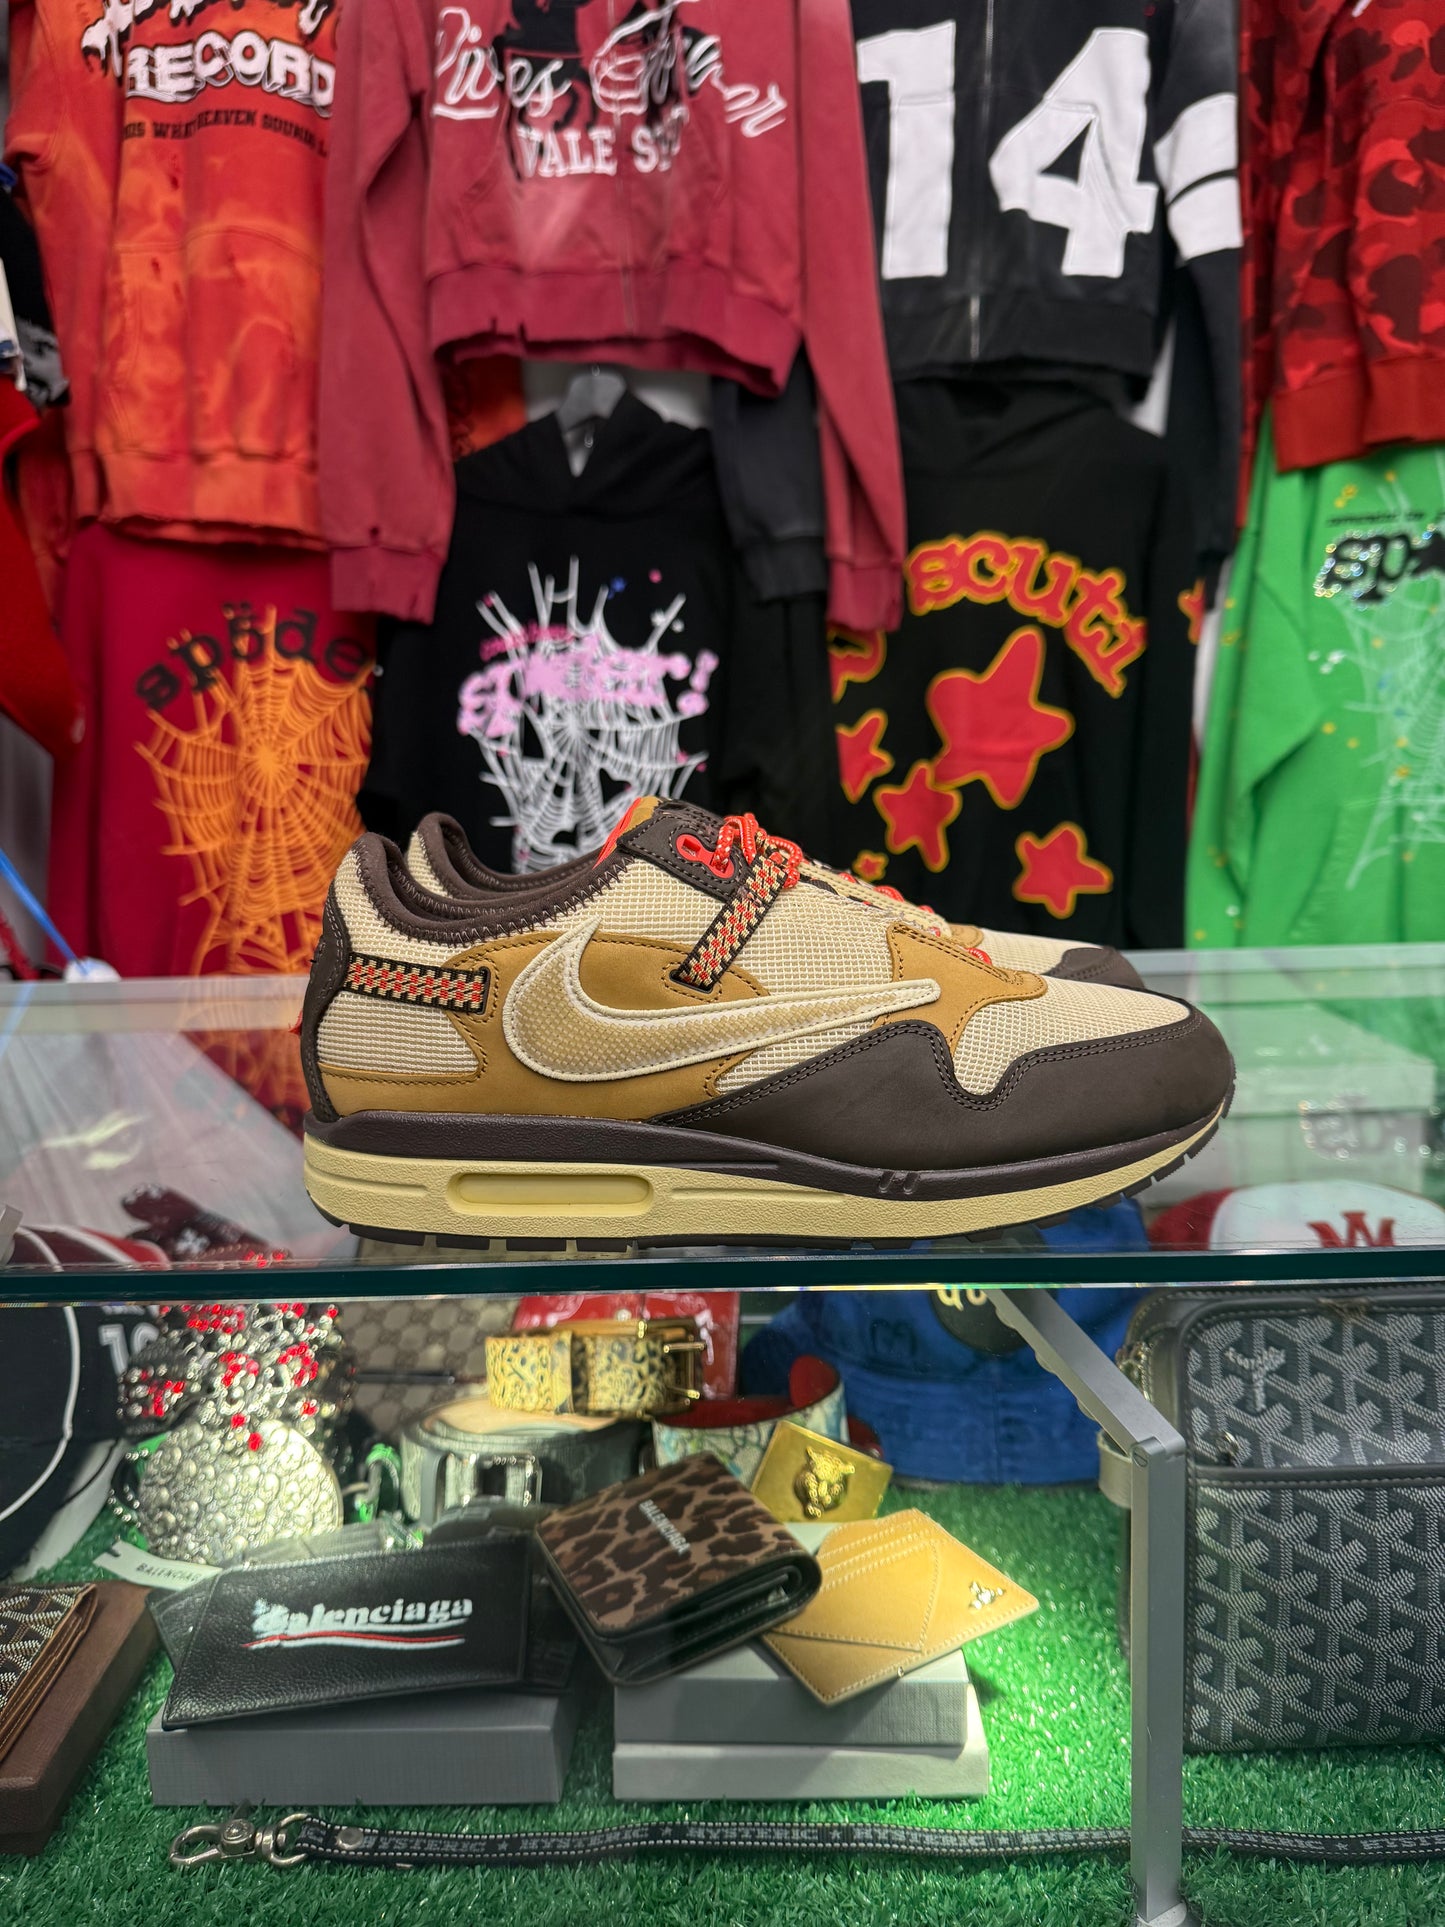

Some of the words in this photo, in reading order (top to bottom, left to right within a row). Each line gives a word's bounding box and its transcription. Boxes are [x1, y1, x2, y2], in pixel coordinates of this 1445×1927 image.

[516, 125, 618, 178] VALE
[856, 20, 1159, 279] 14
[638, 1499, 691, 1557] BALENCIAGA
